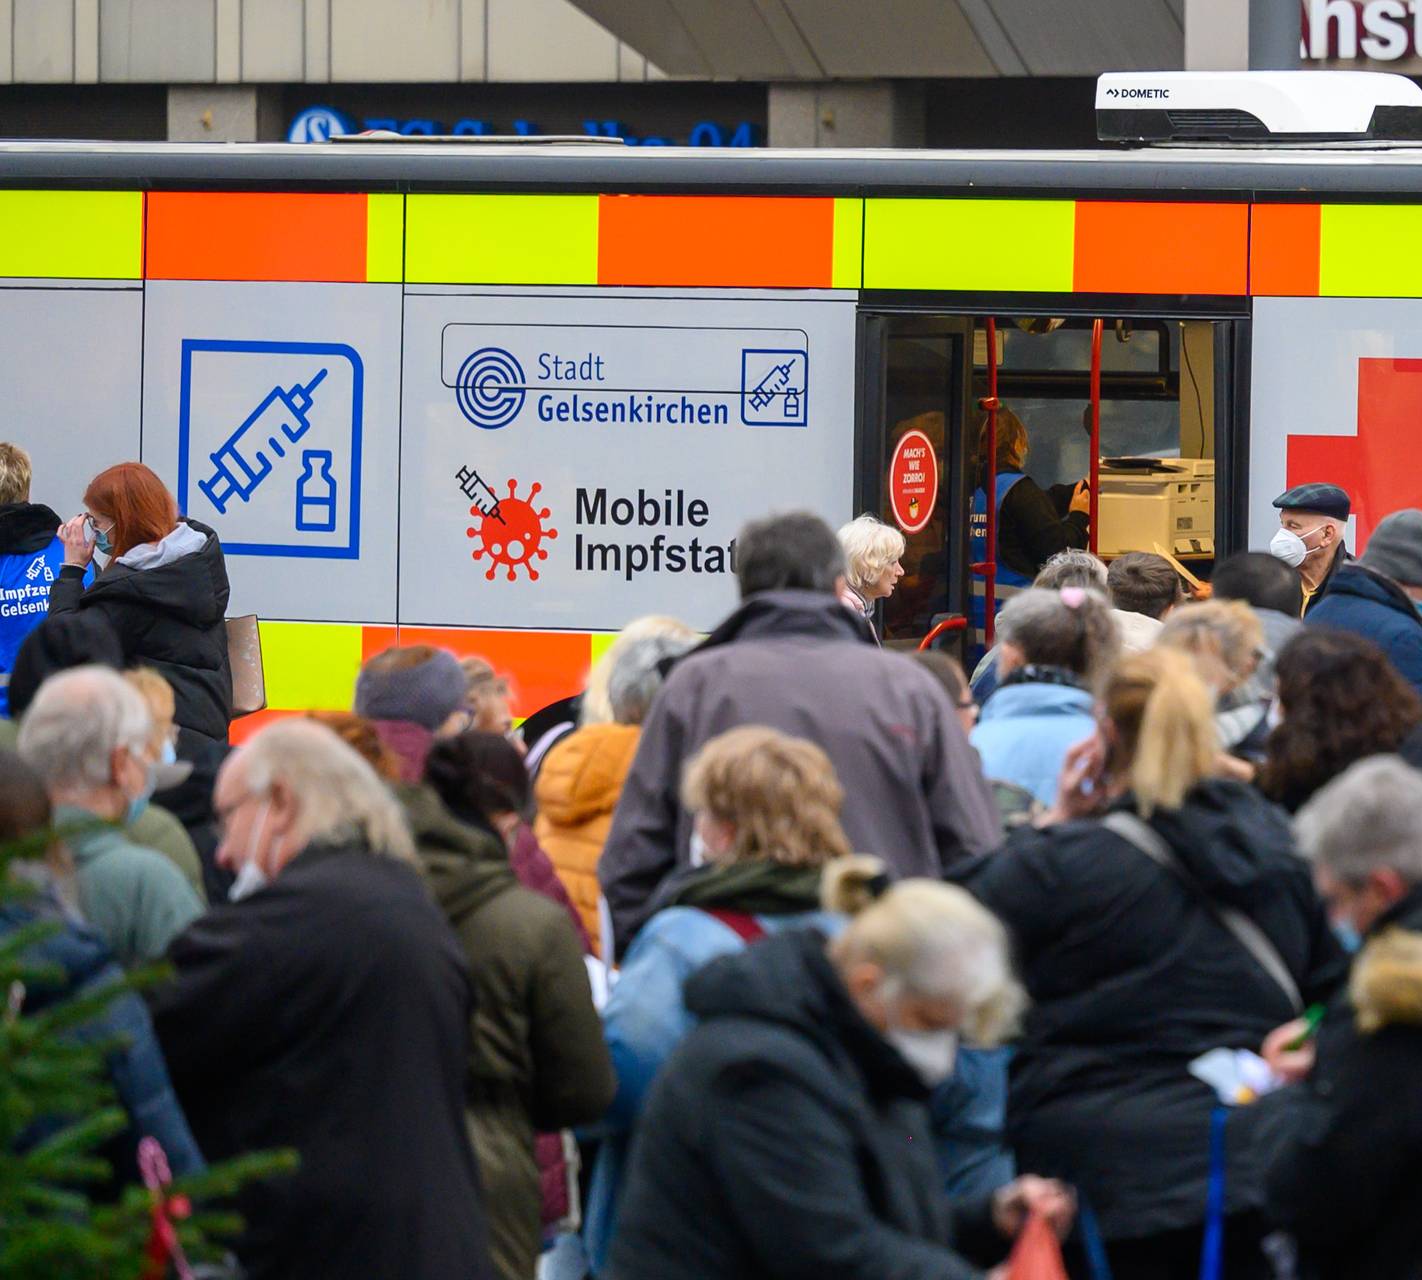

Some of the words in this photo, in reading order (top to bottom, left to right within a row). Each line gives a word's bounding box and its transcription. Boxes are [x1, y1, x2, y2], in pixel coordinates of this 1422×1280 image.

[1121, 89, 1169, 98] DOMETIC
[537, 352, 605, 382] Stadt
[537, 394, 729, 425] Gelsenkirchen
[908, 460, 920, 470] WIE
[575, 487, 709, 526] Mobile
[575, 534, 737, 581] Impfstat
